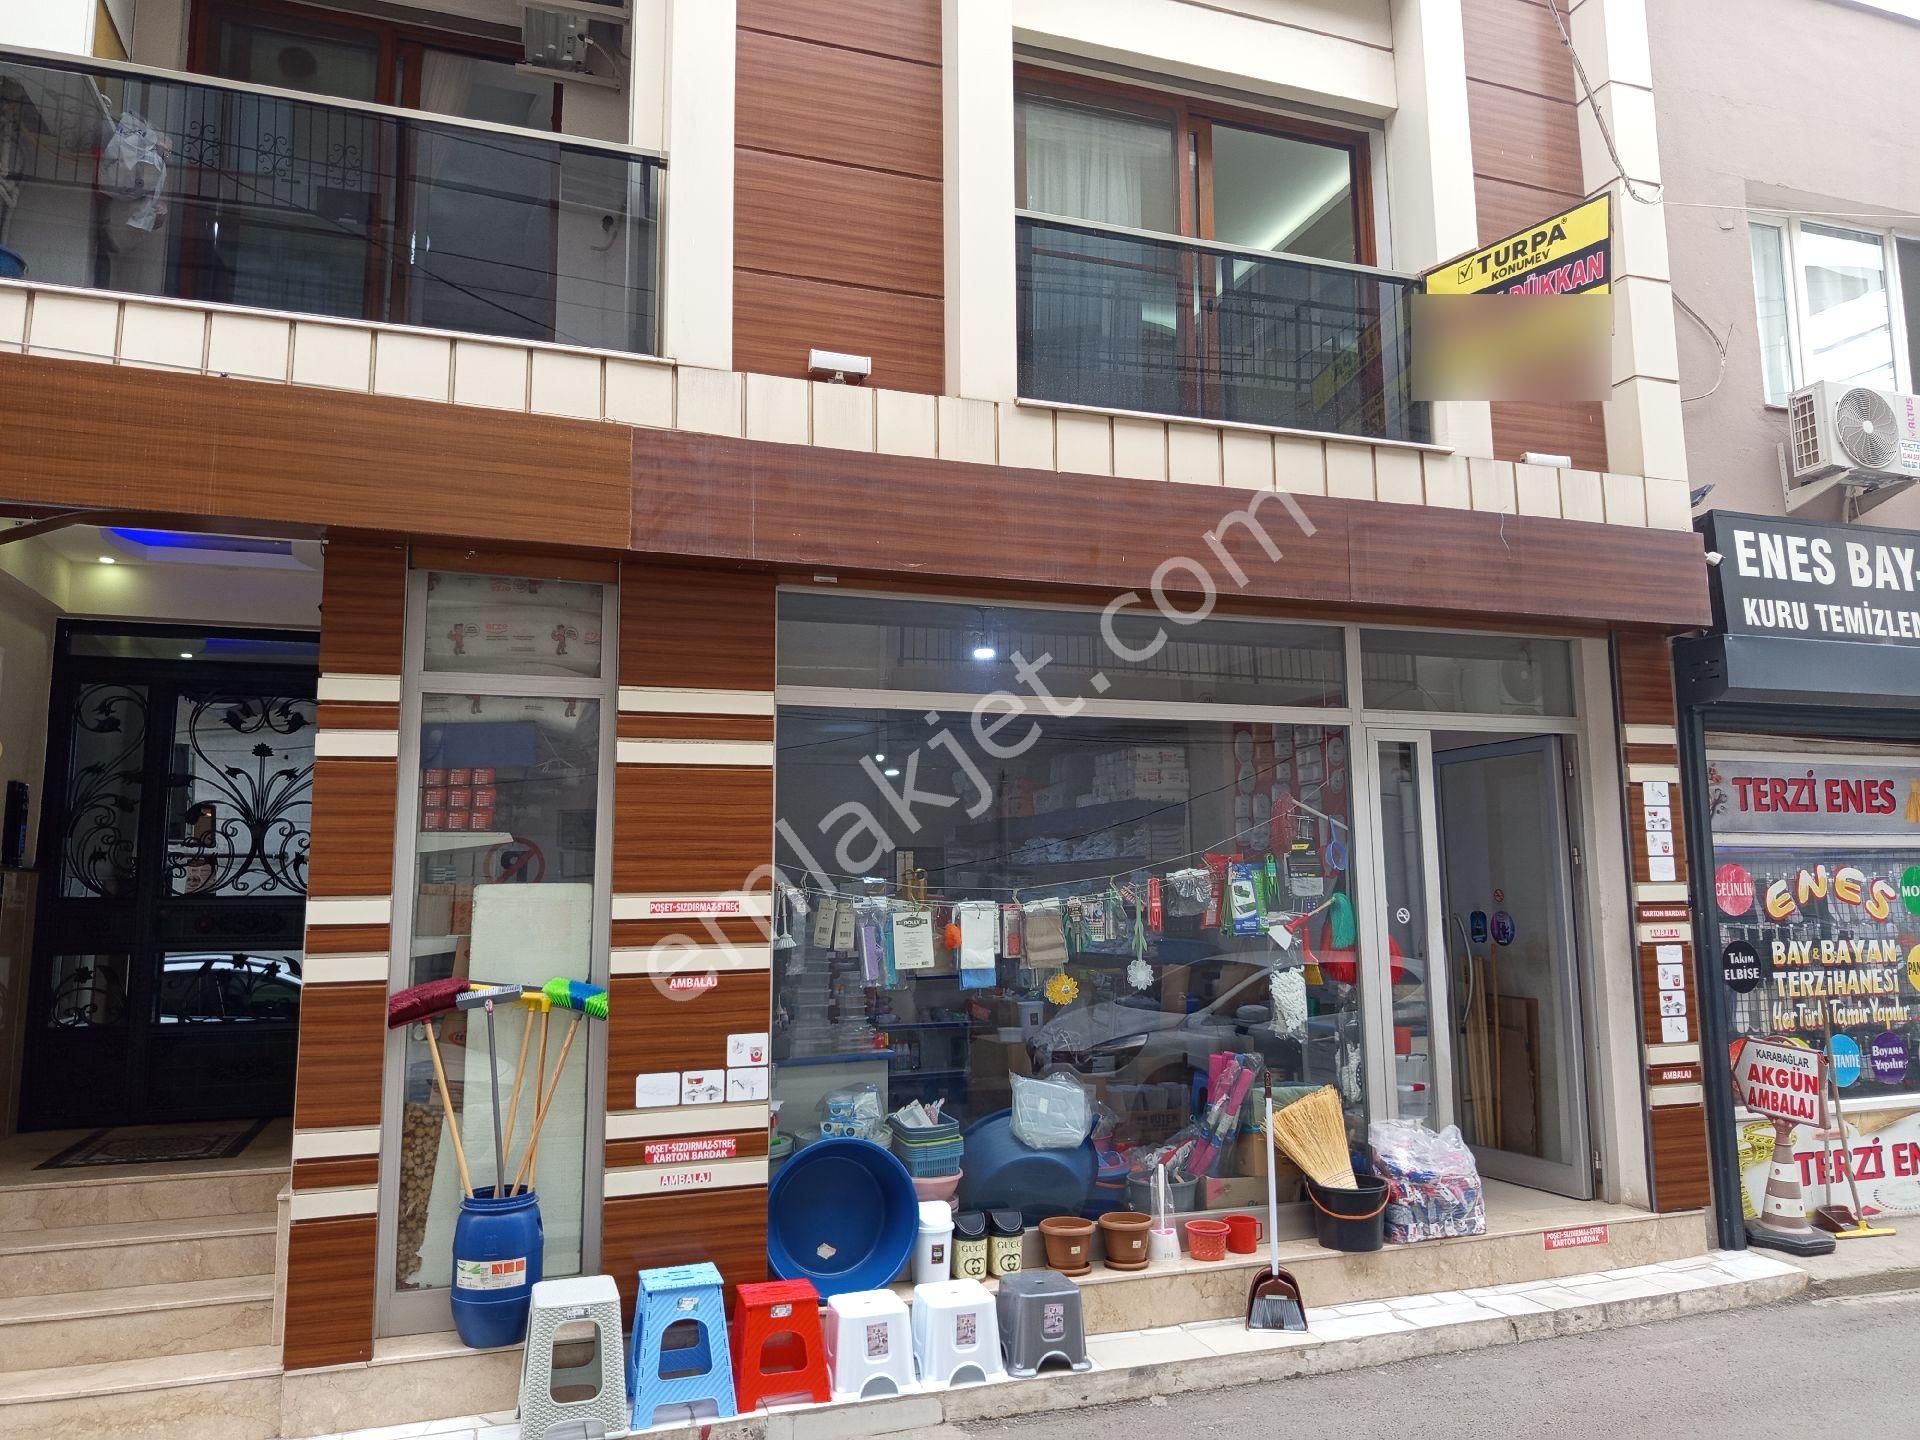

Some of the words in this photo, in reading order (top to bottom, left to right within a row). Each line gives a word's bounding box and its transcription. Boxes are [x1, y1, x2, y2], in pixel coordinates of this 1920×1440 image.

[1477, 223, 1567, 274] TURPA
[1491, 249, 1551, 282] KONUMEV
[1734, 530, 1836, 585] ENES
[1743, 597, 1809, 630] KURU
[1732, 769, 1819, 813] TERZİ
[1824, 779, 1897, 814] ENES
[1765, 864, 1897, 922] ENES
[1902, 885, 1920, 897] MO
[1771, 940, 1812, 967] BAY
[1820, 940, 1897, 964] BAYAN
[670, 976, 718, 989] AMBALAJ
[1773, 1001, 1798, 1031] Her
[1830, 1000, 1870, 1027] Tamir
[1662, 1070, 1692, 1080] AMBALAJ
[1756, 1049, 1810, 1069] KARABAĞLAR
[1747, 1063, 1819, 1096] AKGÜN
[1749, 1087, 1815, 1120] AMBALAJ
[653, 1152, 690, 1164] KARTON
[691, 1149, 728, 1160] BARDAK
[1793, 1137, 1886, 1187] TERZİ
[661, 1172, 712, 1187] AMBALAJ
[1553, 1238, 1575, 1248] KARTON
[1577, 1235, 1599, 1246] BARDAK
